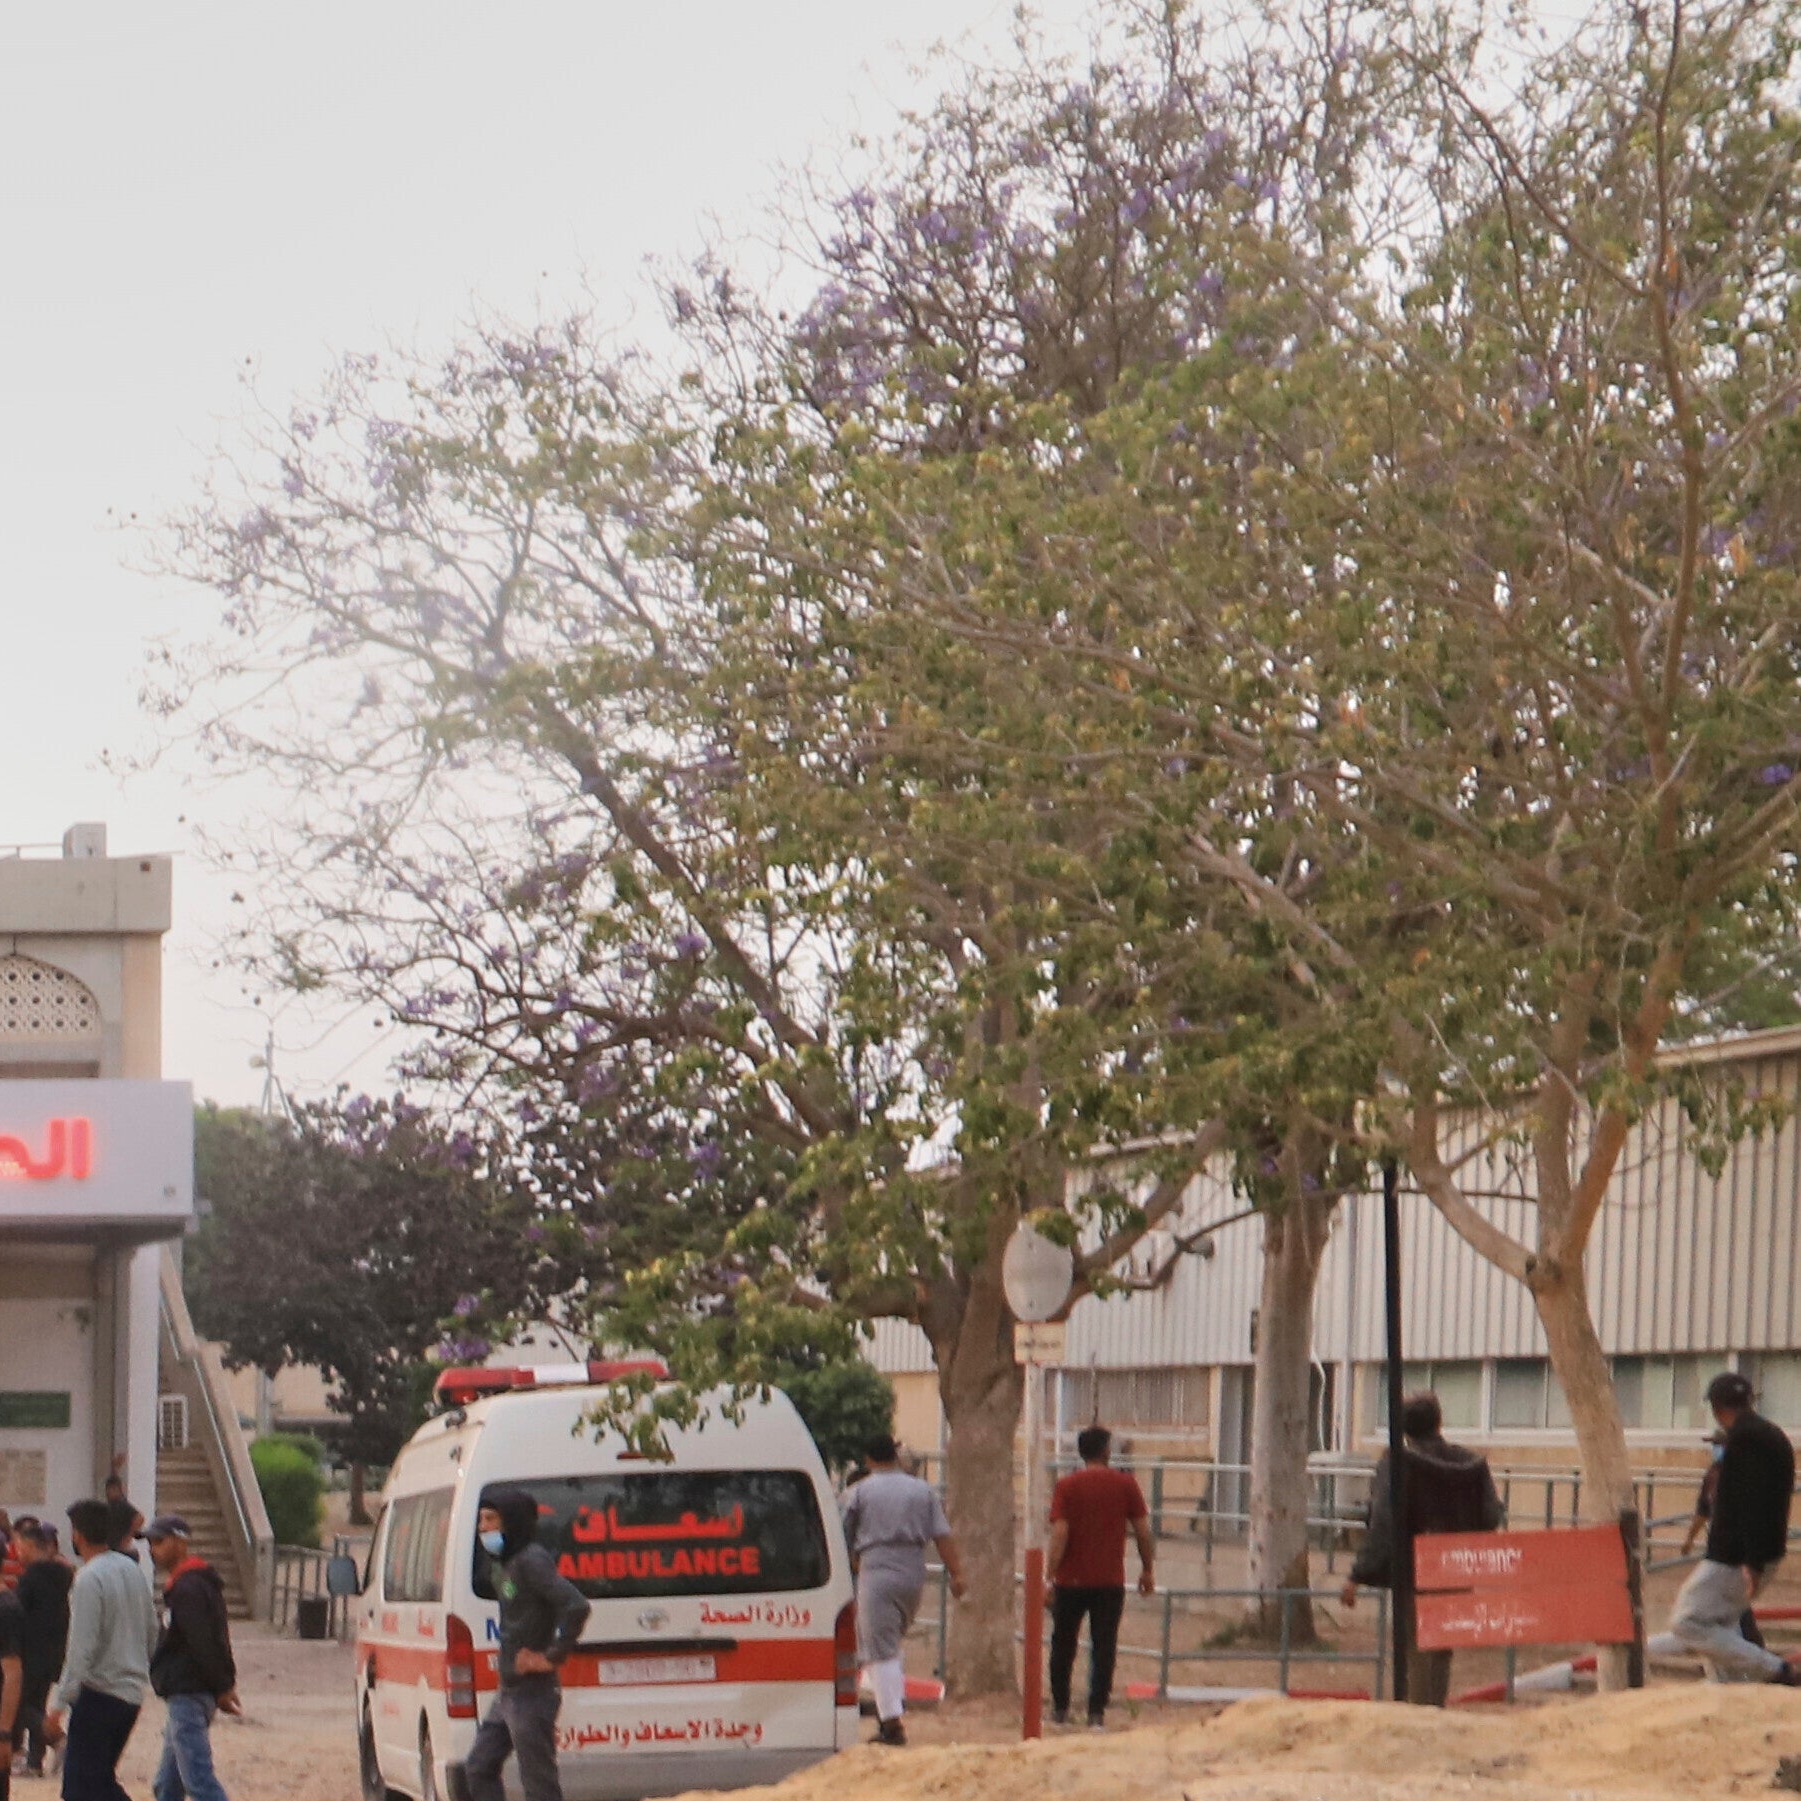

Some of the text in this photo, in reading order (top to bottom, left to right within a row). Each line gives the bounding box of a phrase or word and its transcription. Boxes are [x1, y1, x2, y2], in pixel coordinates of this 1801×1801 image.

[556, 1547, 761, 1580] AMBULANCE
[700, 1600, 811, 1628] وزارة الصحة
[715, 1717, 763, 1745] وحدة
